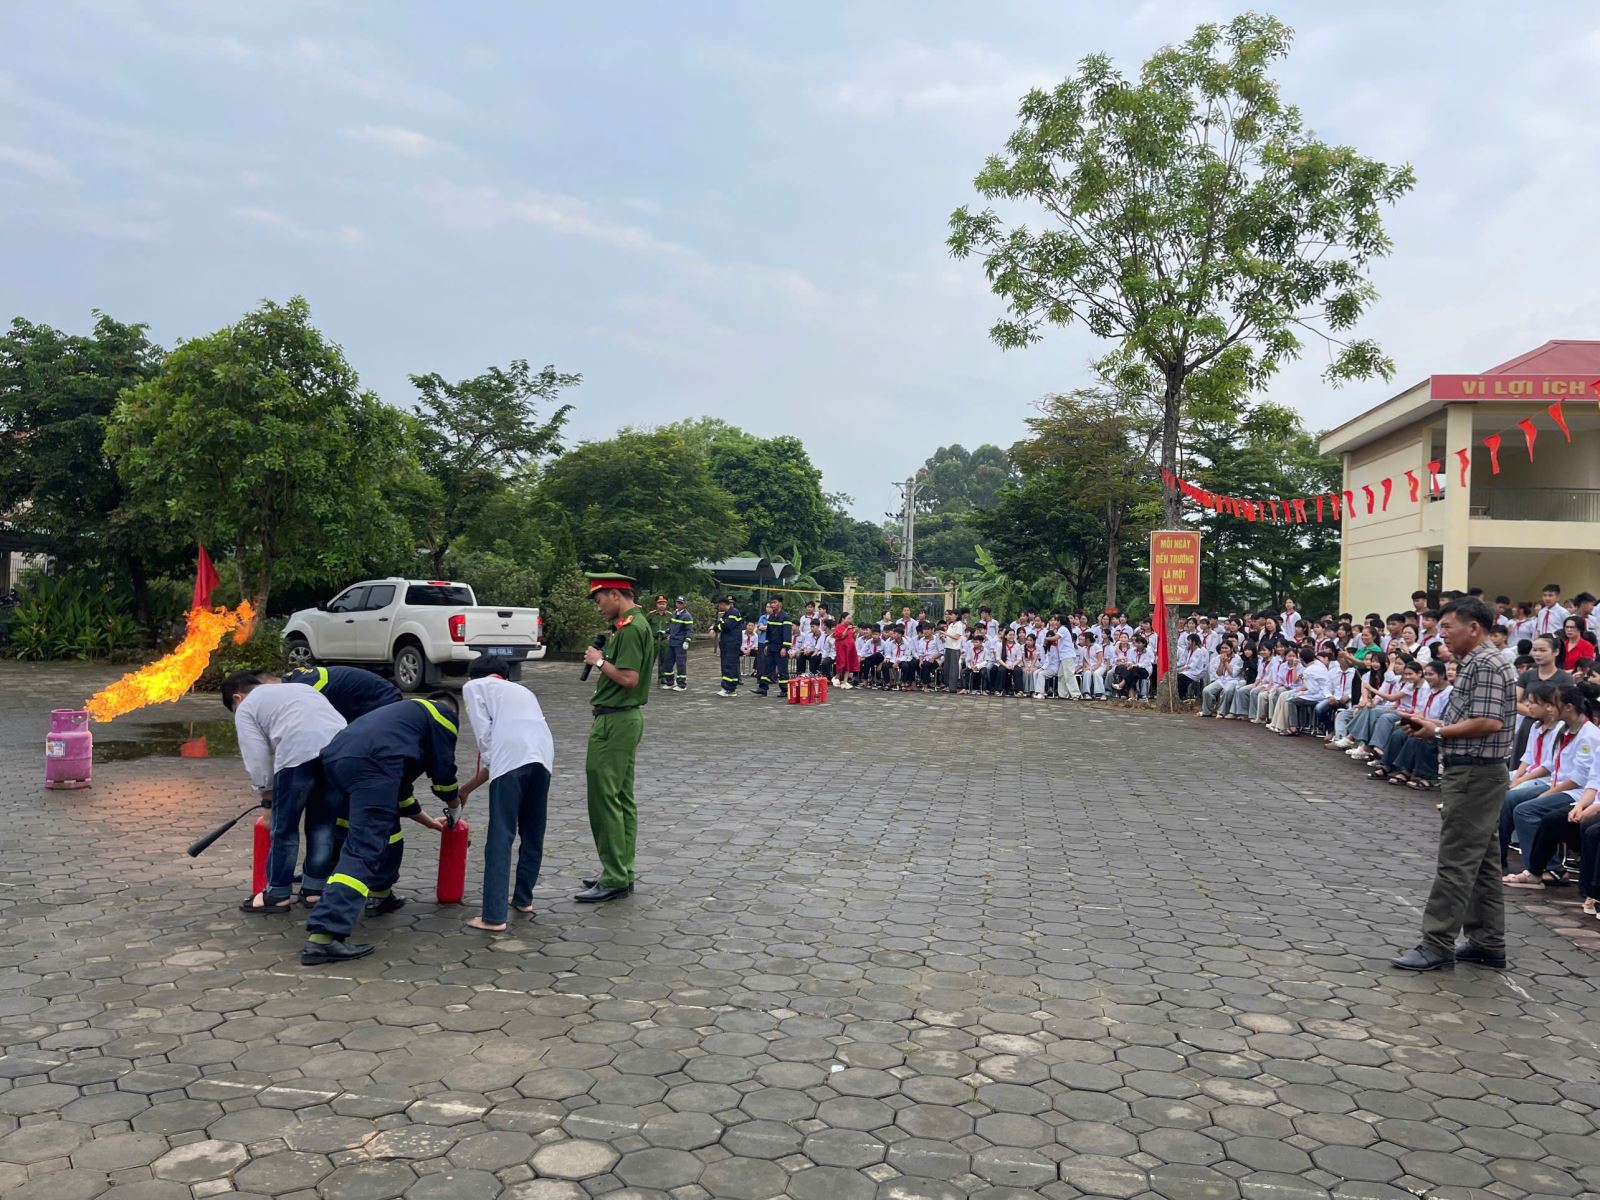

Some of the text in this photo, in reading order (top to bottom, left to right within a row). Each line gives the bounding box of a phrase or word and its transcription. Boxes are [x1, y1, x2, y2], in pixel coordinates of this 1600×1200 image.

[1462, 377, 1585, 398] VÌ LỢI ÍCH
[1174, 538, 1191, 548] NGÀY
[1163, 568, 1186, 580] LÀ MỘT
[1178, 584, 1188, 594] VUI
